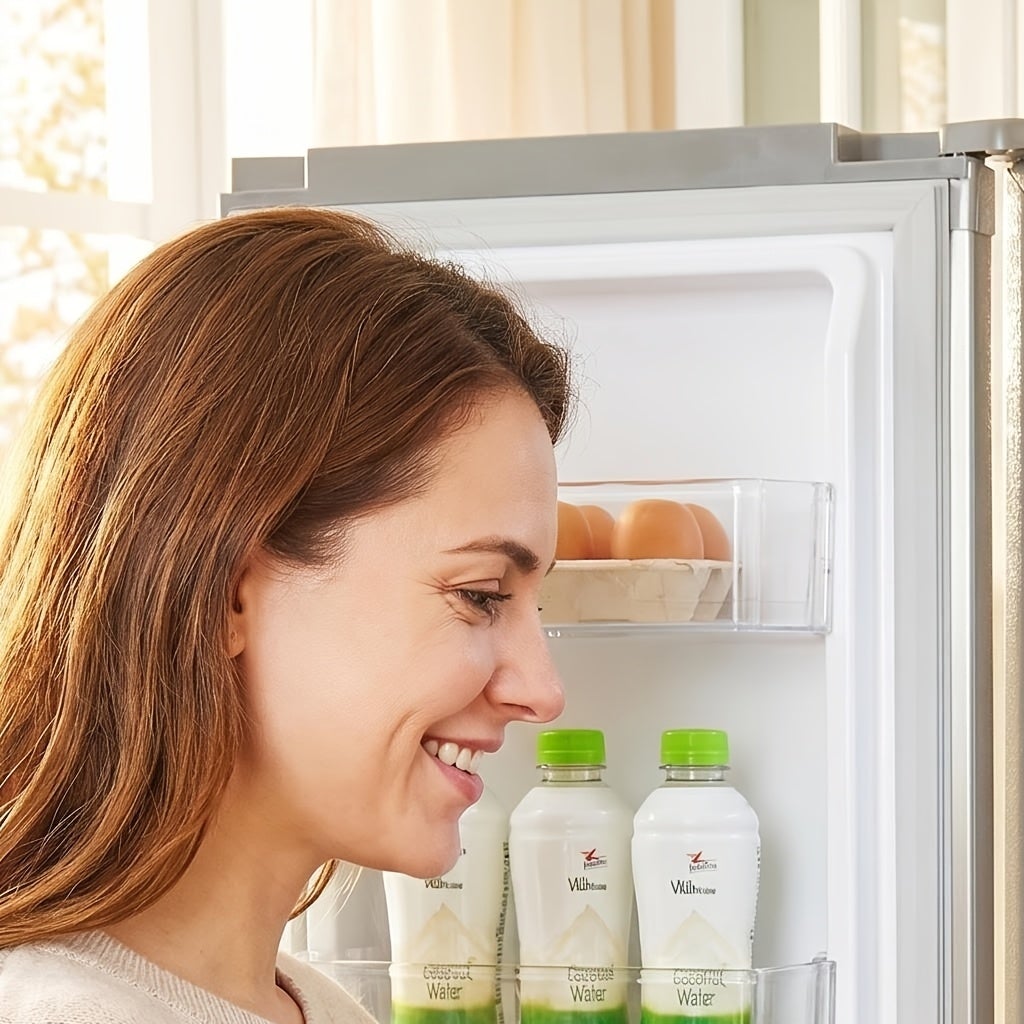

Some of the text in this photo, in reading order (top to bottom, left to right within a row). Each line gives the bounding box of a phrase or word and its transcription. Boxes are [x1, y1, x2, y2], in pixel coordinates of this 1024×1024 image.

[426, 983, 463, 1000] Water
[570, 984, 607, 1002] Water
[677, 988, 716, 1006] Water
